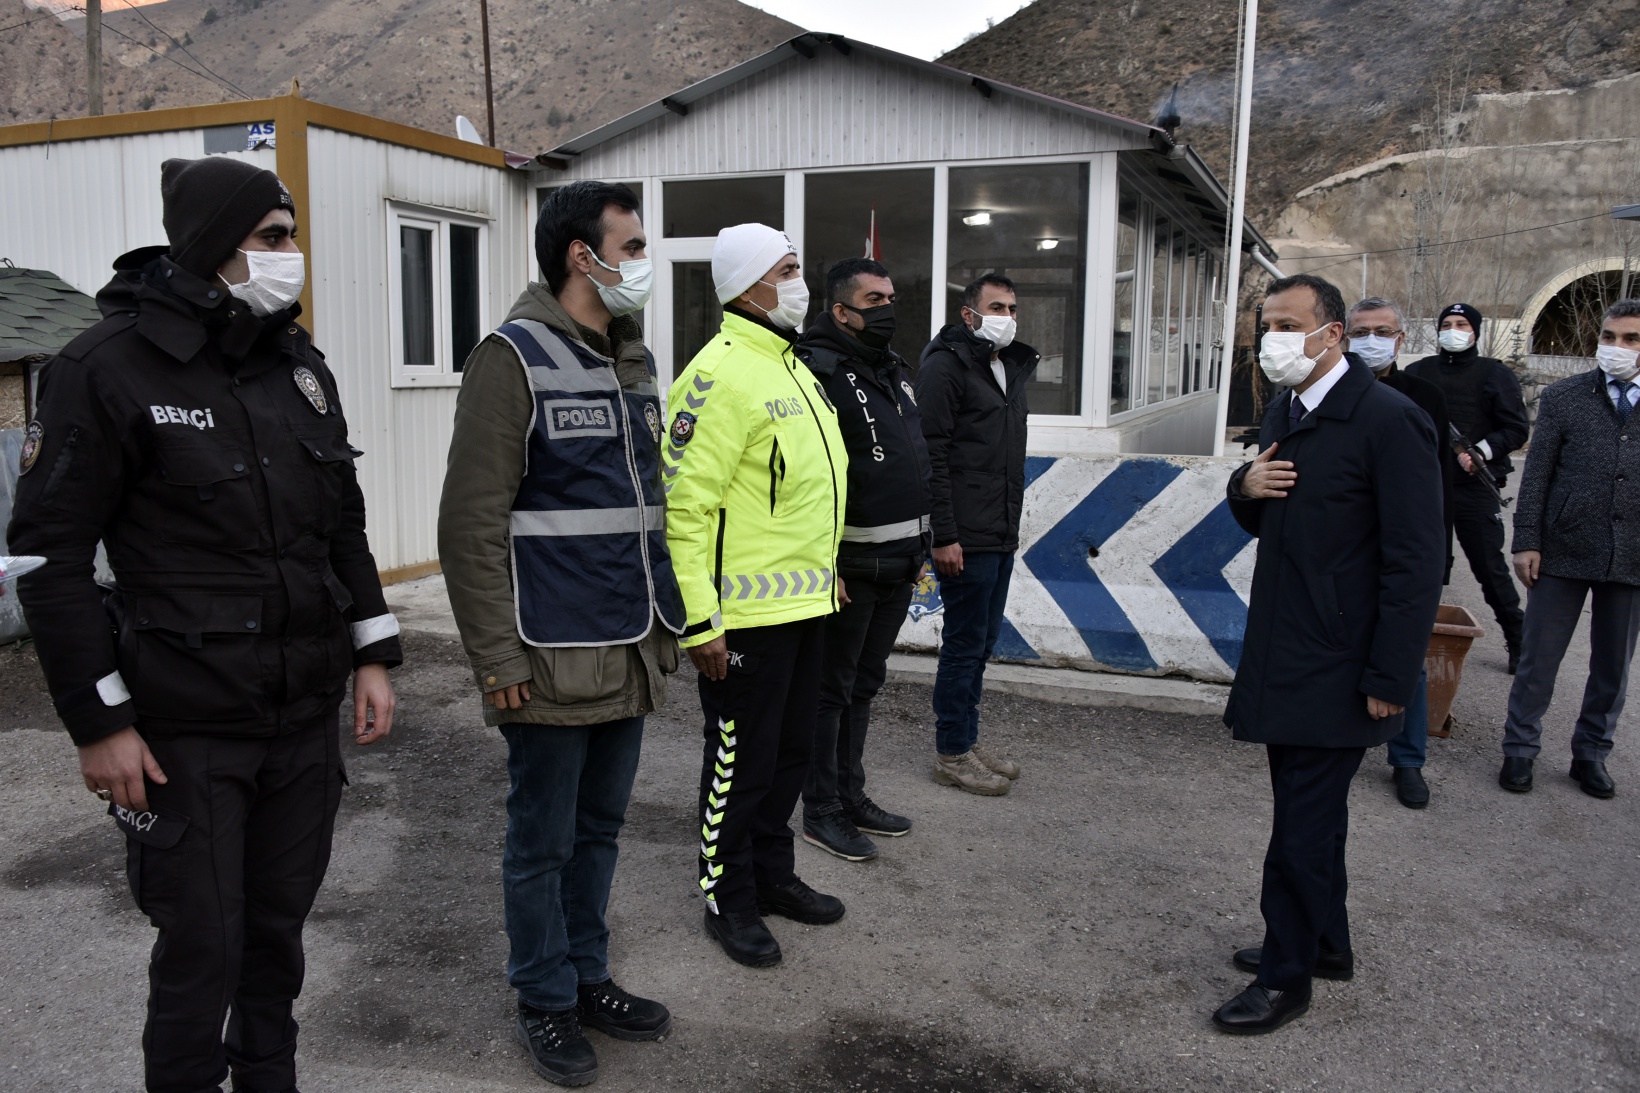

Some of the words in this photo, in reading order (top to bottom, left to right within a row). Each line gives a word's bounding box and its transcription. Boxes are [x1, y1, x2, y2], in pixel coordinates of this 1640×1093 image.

[246, 122, 275, 135] AS
[150, 405, 215, 430] BEKÇİ
[557, 409, 607, 428] POLİS
[764, 397, 804, 421] POLİS
